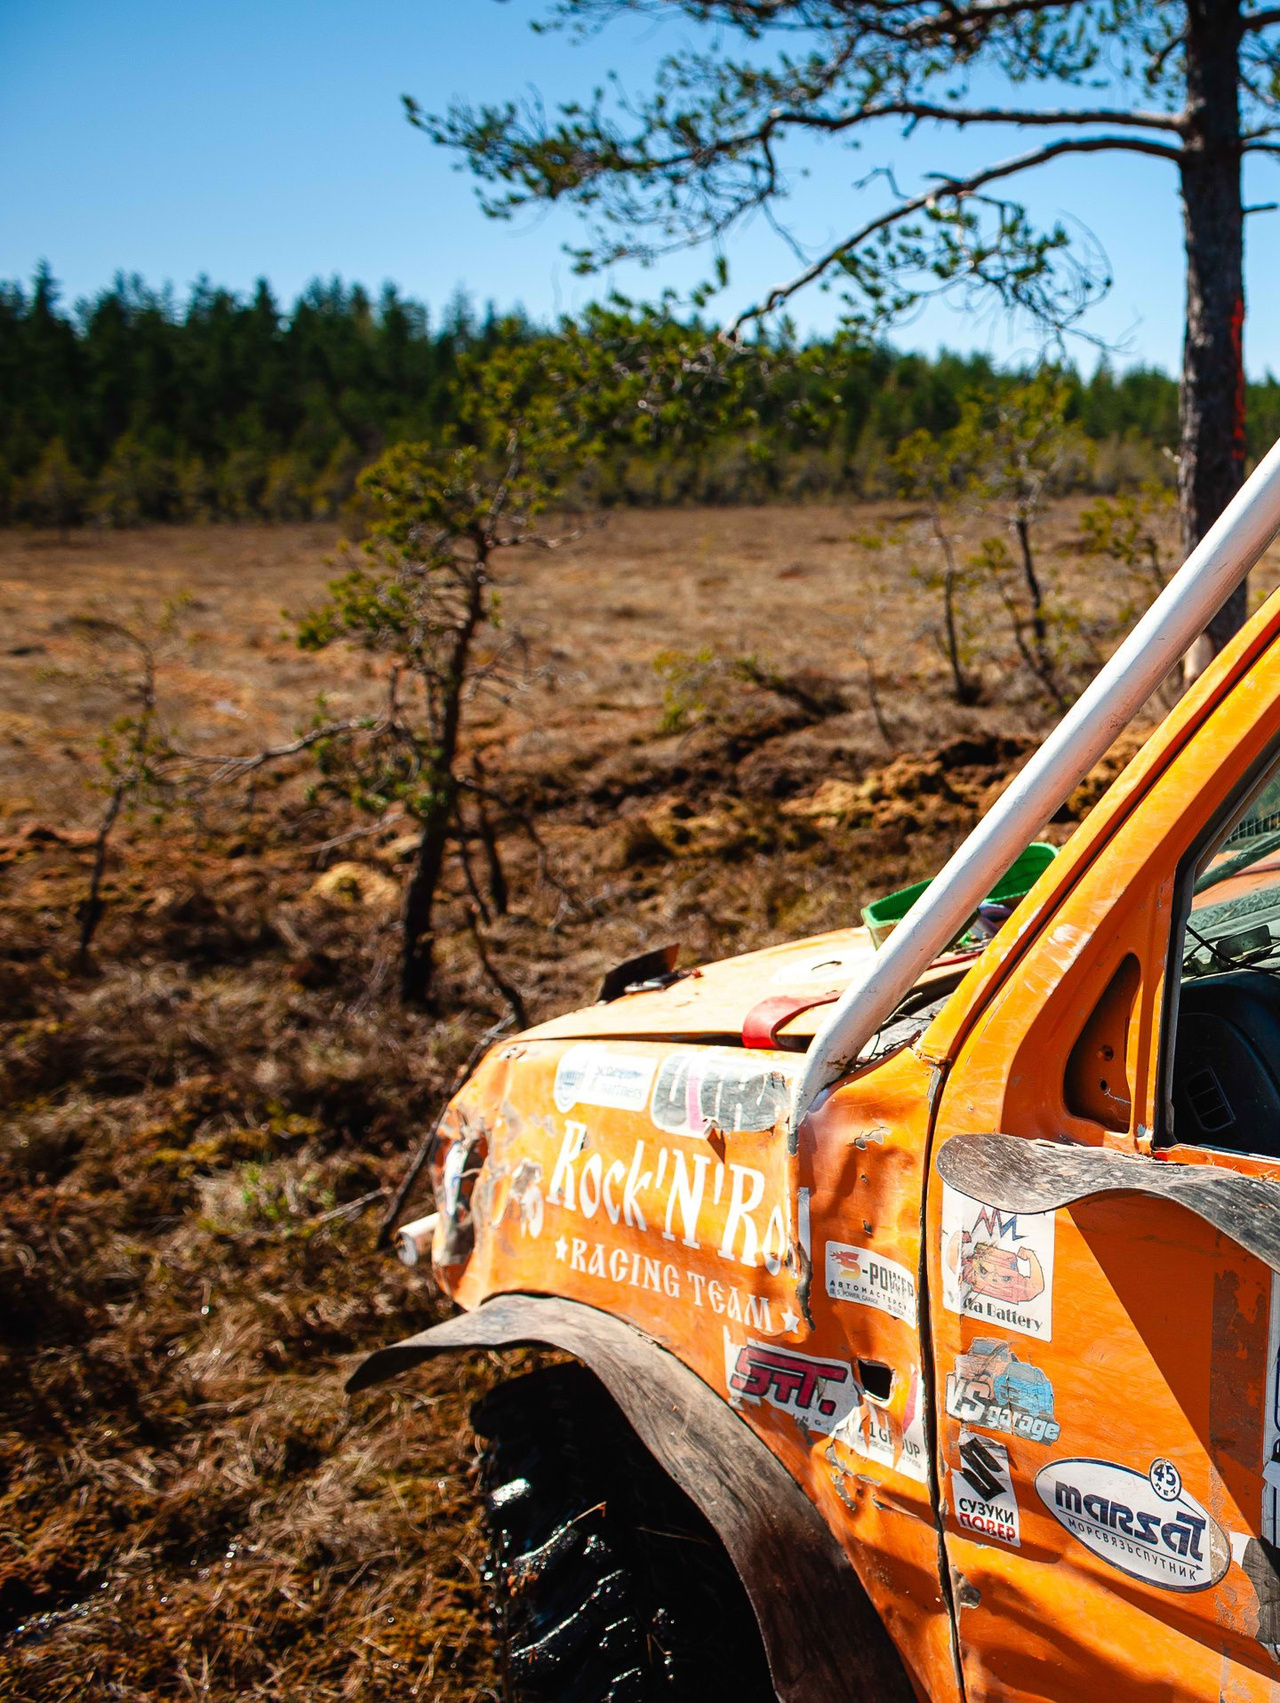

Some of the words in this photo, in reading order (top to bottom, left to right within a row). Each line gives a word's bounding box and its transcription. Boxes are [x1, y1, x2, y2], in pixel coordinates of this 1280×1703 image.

[570, 1237, 681, 1299] RACING
[686, 1270, 776, 1333] TEAM
[986, 1302, 1044, 1332] Battery
[945, 1373, 993, 1423] VS
[988, 1404, 1061, 1442] garage
[878, 1427, 921, 1459] GUP
[1153, 1463, 1177, 1487] 45
[1154, 1481, 1177, 1497] ЛЕТ
[958, 1497, 1015, 1526] СУЗУКИ
[958, 1512, 1017, 1543] ПОВЕР
